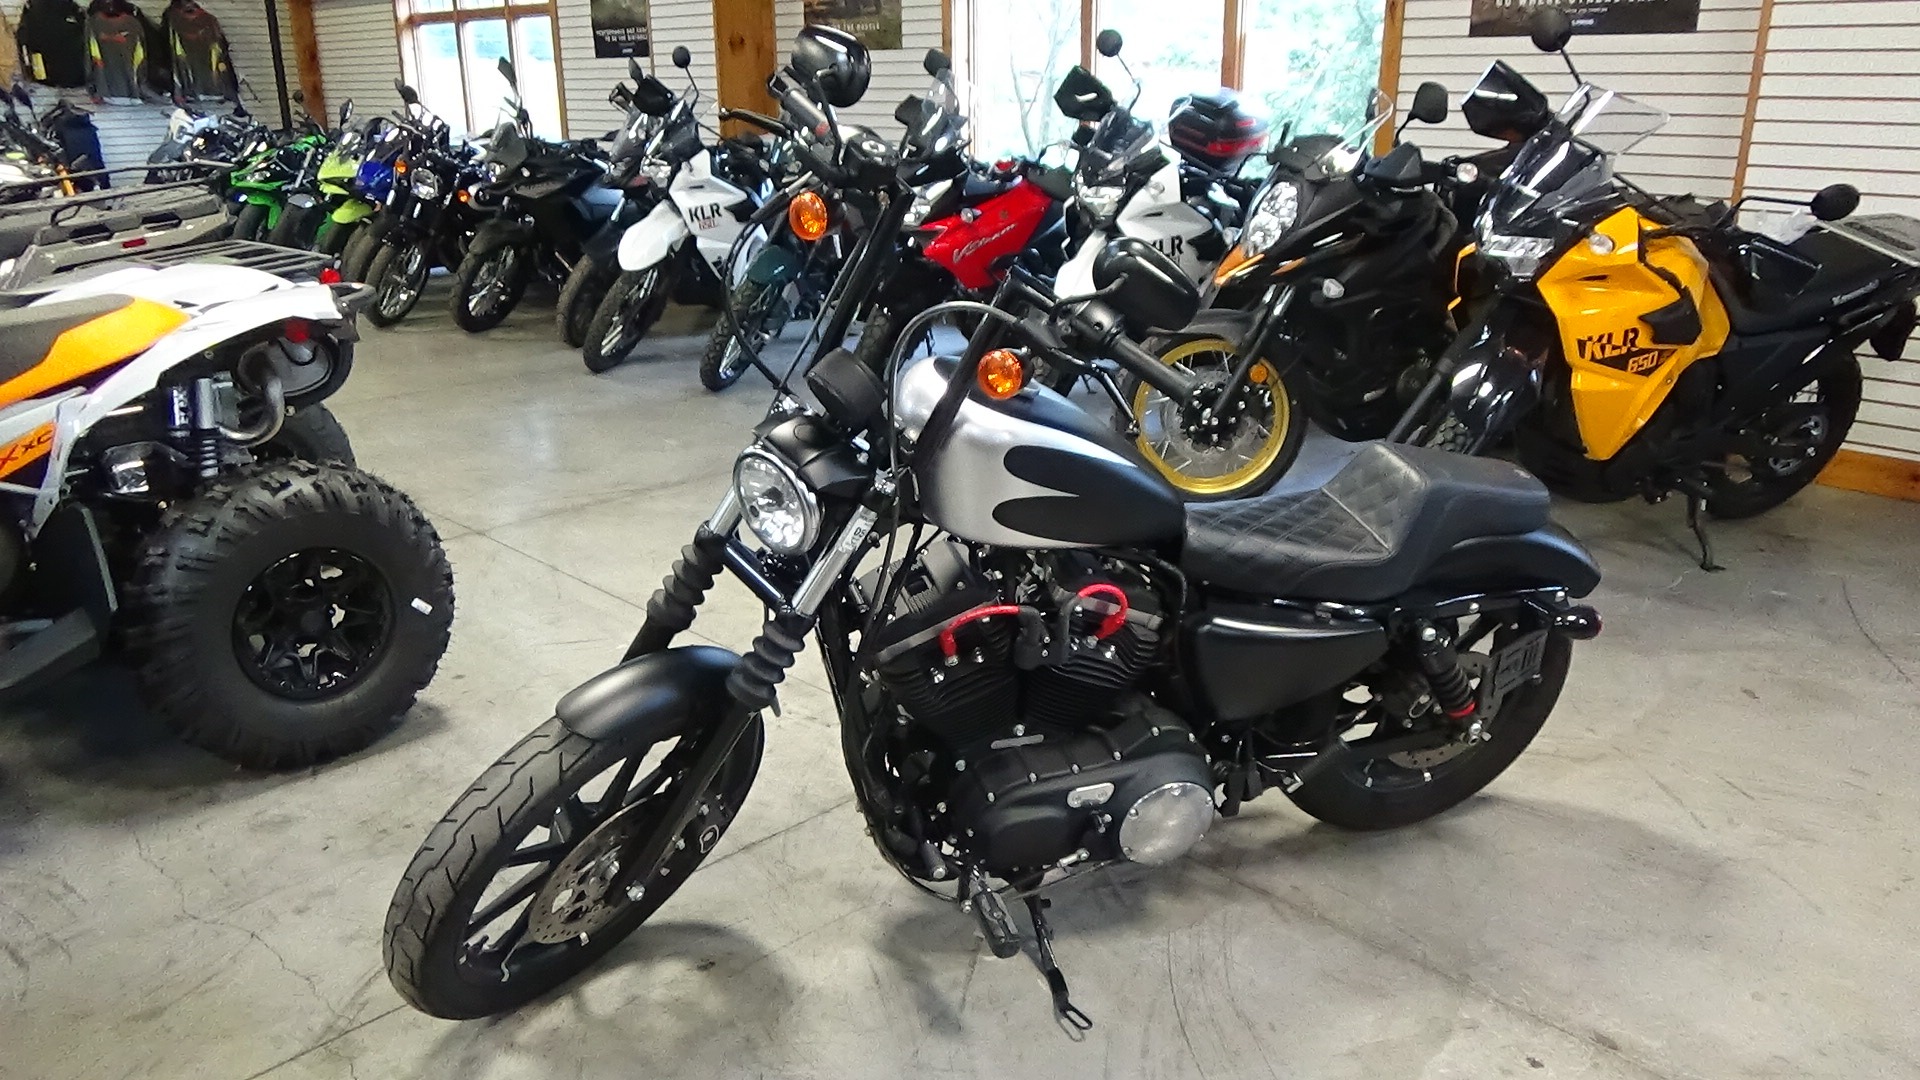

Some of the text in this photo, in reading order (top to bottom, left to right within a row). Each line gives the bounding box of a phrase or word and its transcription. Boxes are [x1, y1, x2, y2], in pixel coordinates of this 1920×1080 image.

[688, 203, 723, 222] KLR
[1583, 327, 1640, 360] KLR
[1627, 351, 1659, 373] 650
